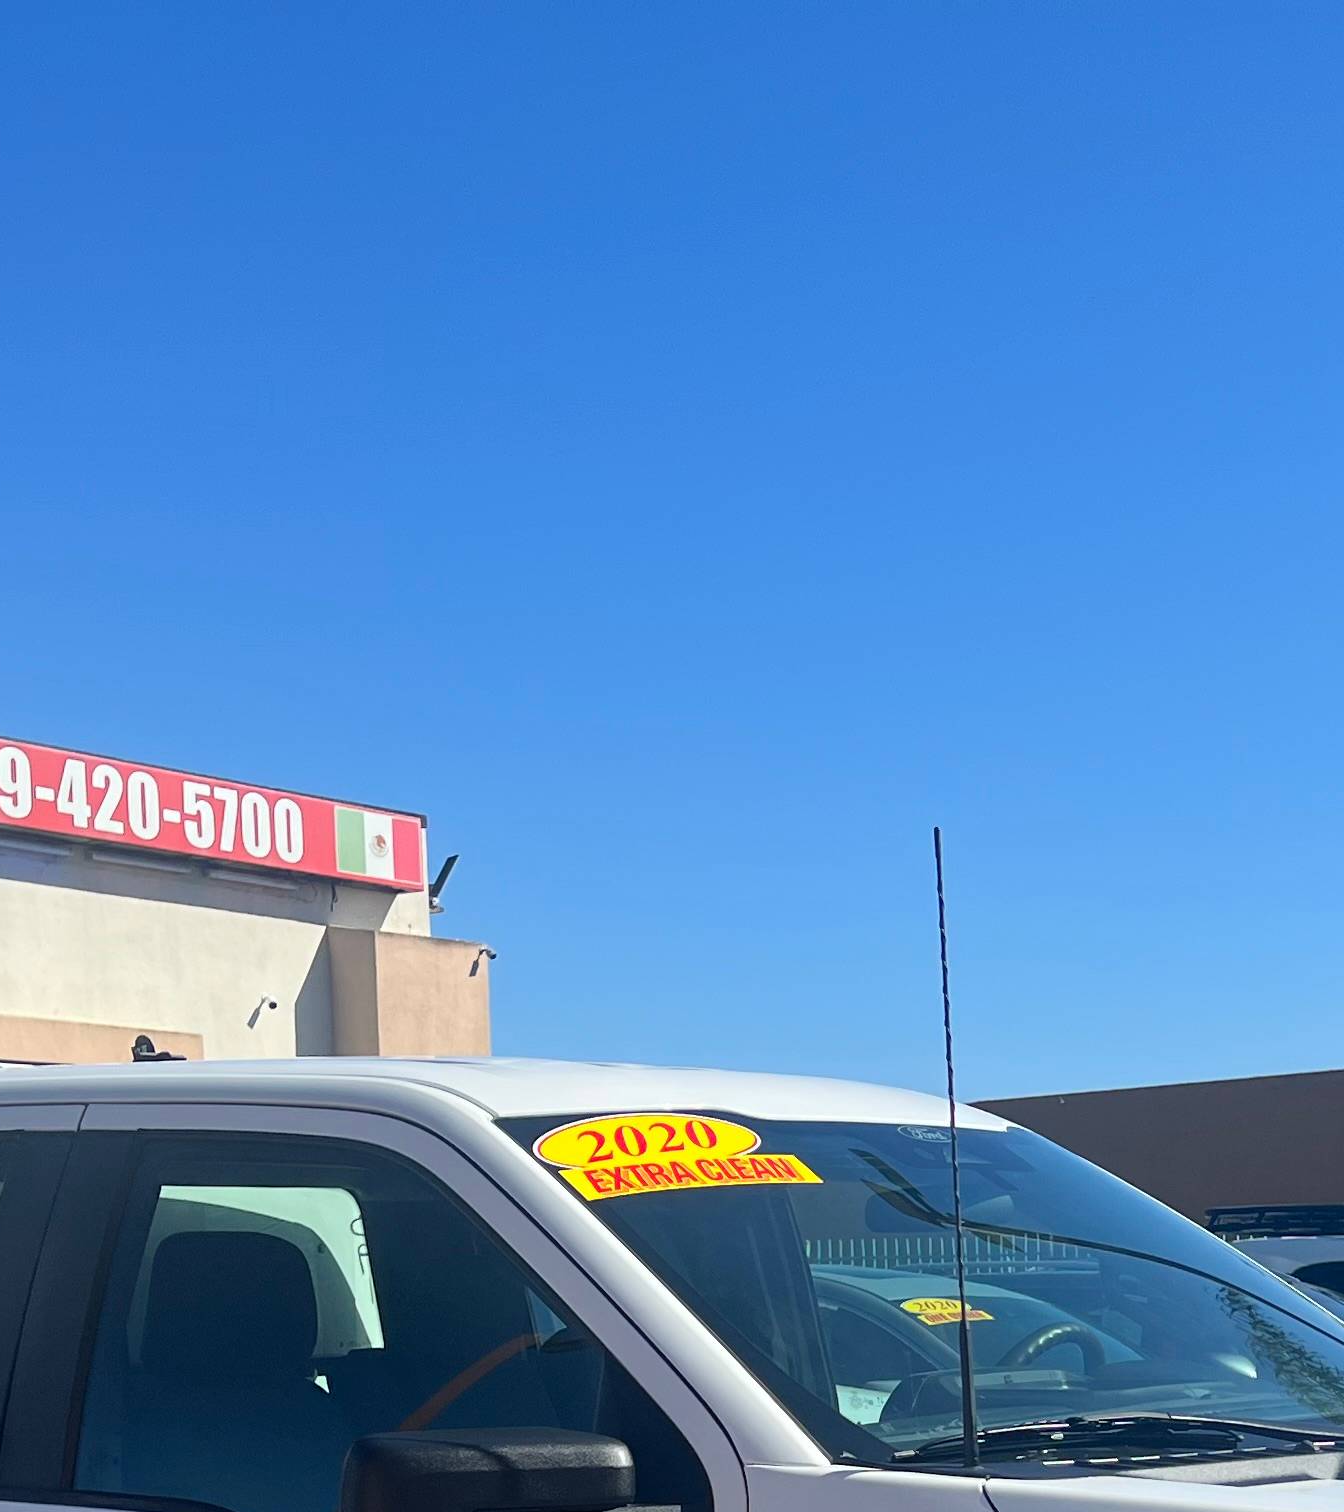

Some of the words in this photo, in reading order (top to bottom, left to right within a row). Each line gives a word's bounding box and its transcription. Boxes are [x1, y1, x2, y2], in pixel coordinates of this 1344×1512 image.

[577, 1120, 718, 1164] 2020
[585, 1158, 703, 1194] EXTRA
[696, 1156, 800, 1182] CLEAN
[912, 1300, 958, 1312] 2020
